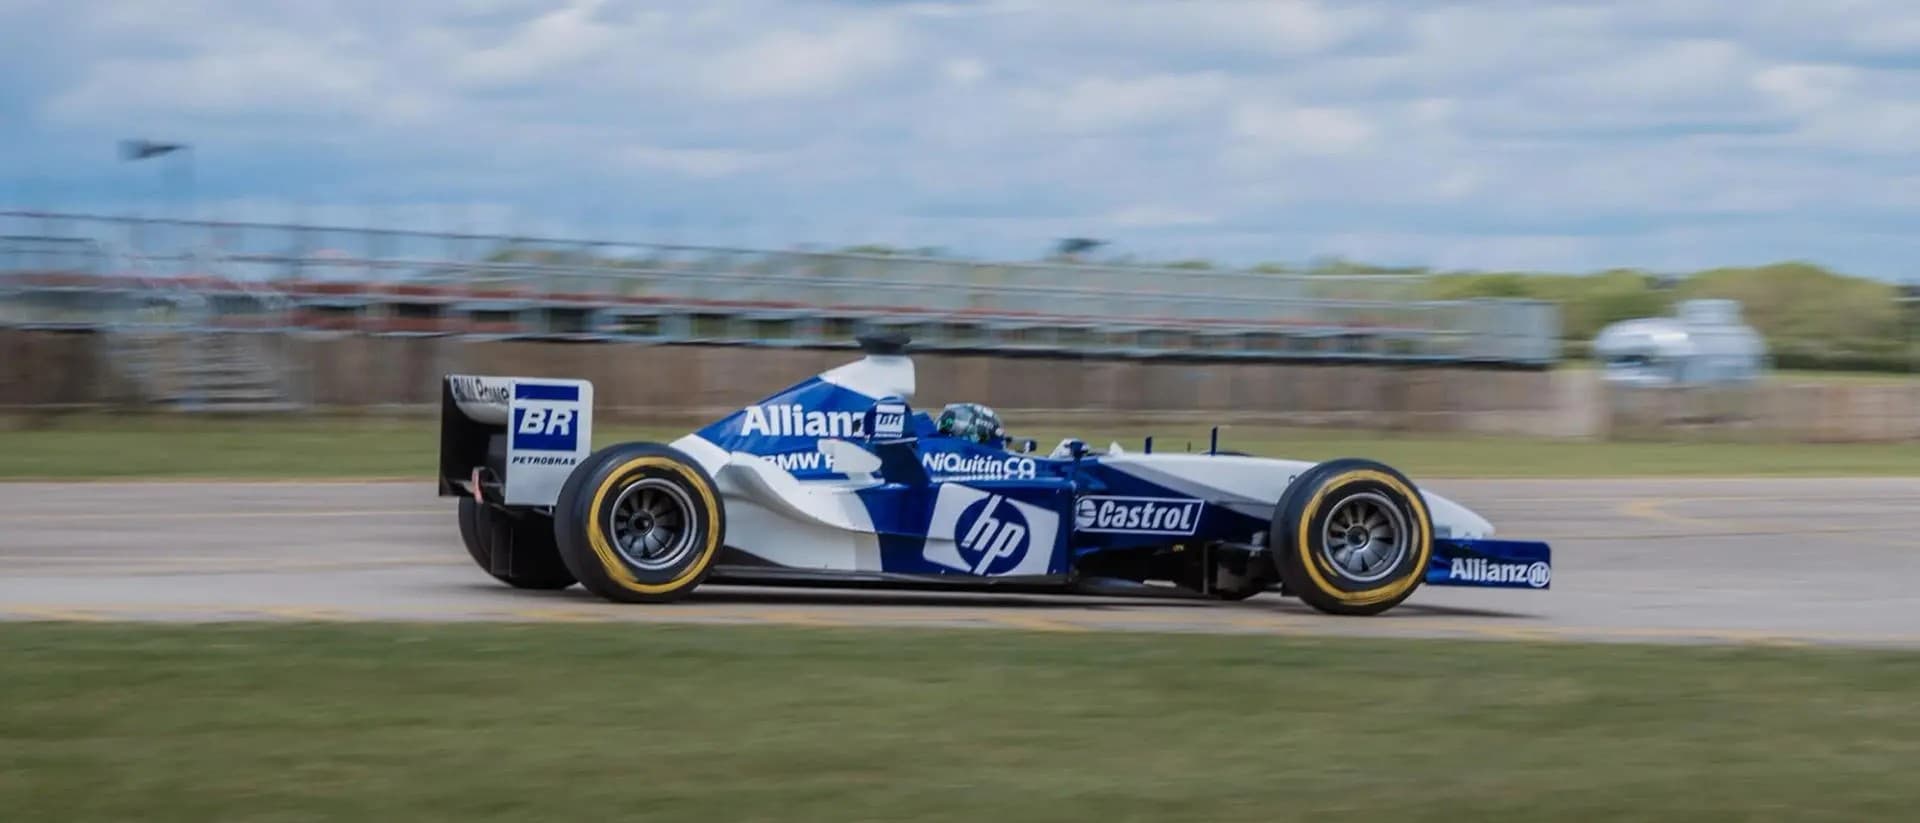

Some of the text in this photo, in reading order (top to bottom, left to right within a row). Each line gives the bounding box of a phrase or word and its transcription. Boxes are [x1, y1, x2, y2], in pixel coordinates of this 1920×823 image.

[518, 409, 573, 435] BR
[512, 456, 576, 465] PETROBRAS
[1098, 500, 1193, 530] Castrol
[960, 494, 1025, 576] hp
[1449, 558, 1528, 583] Allianz
